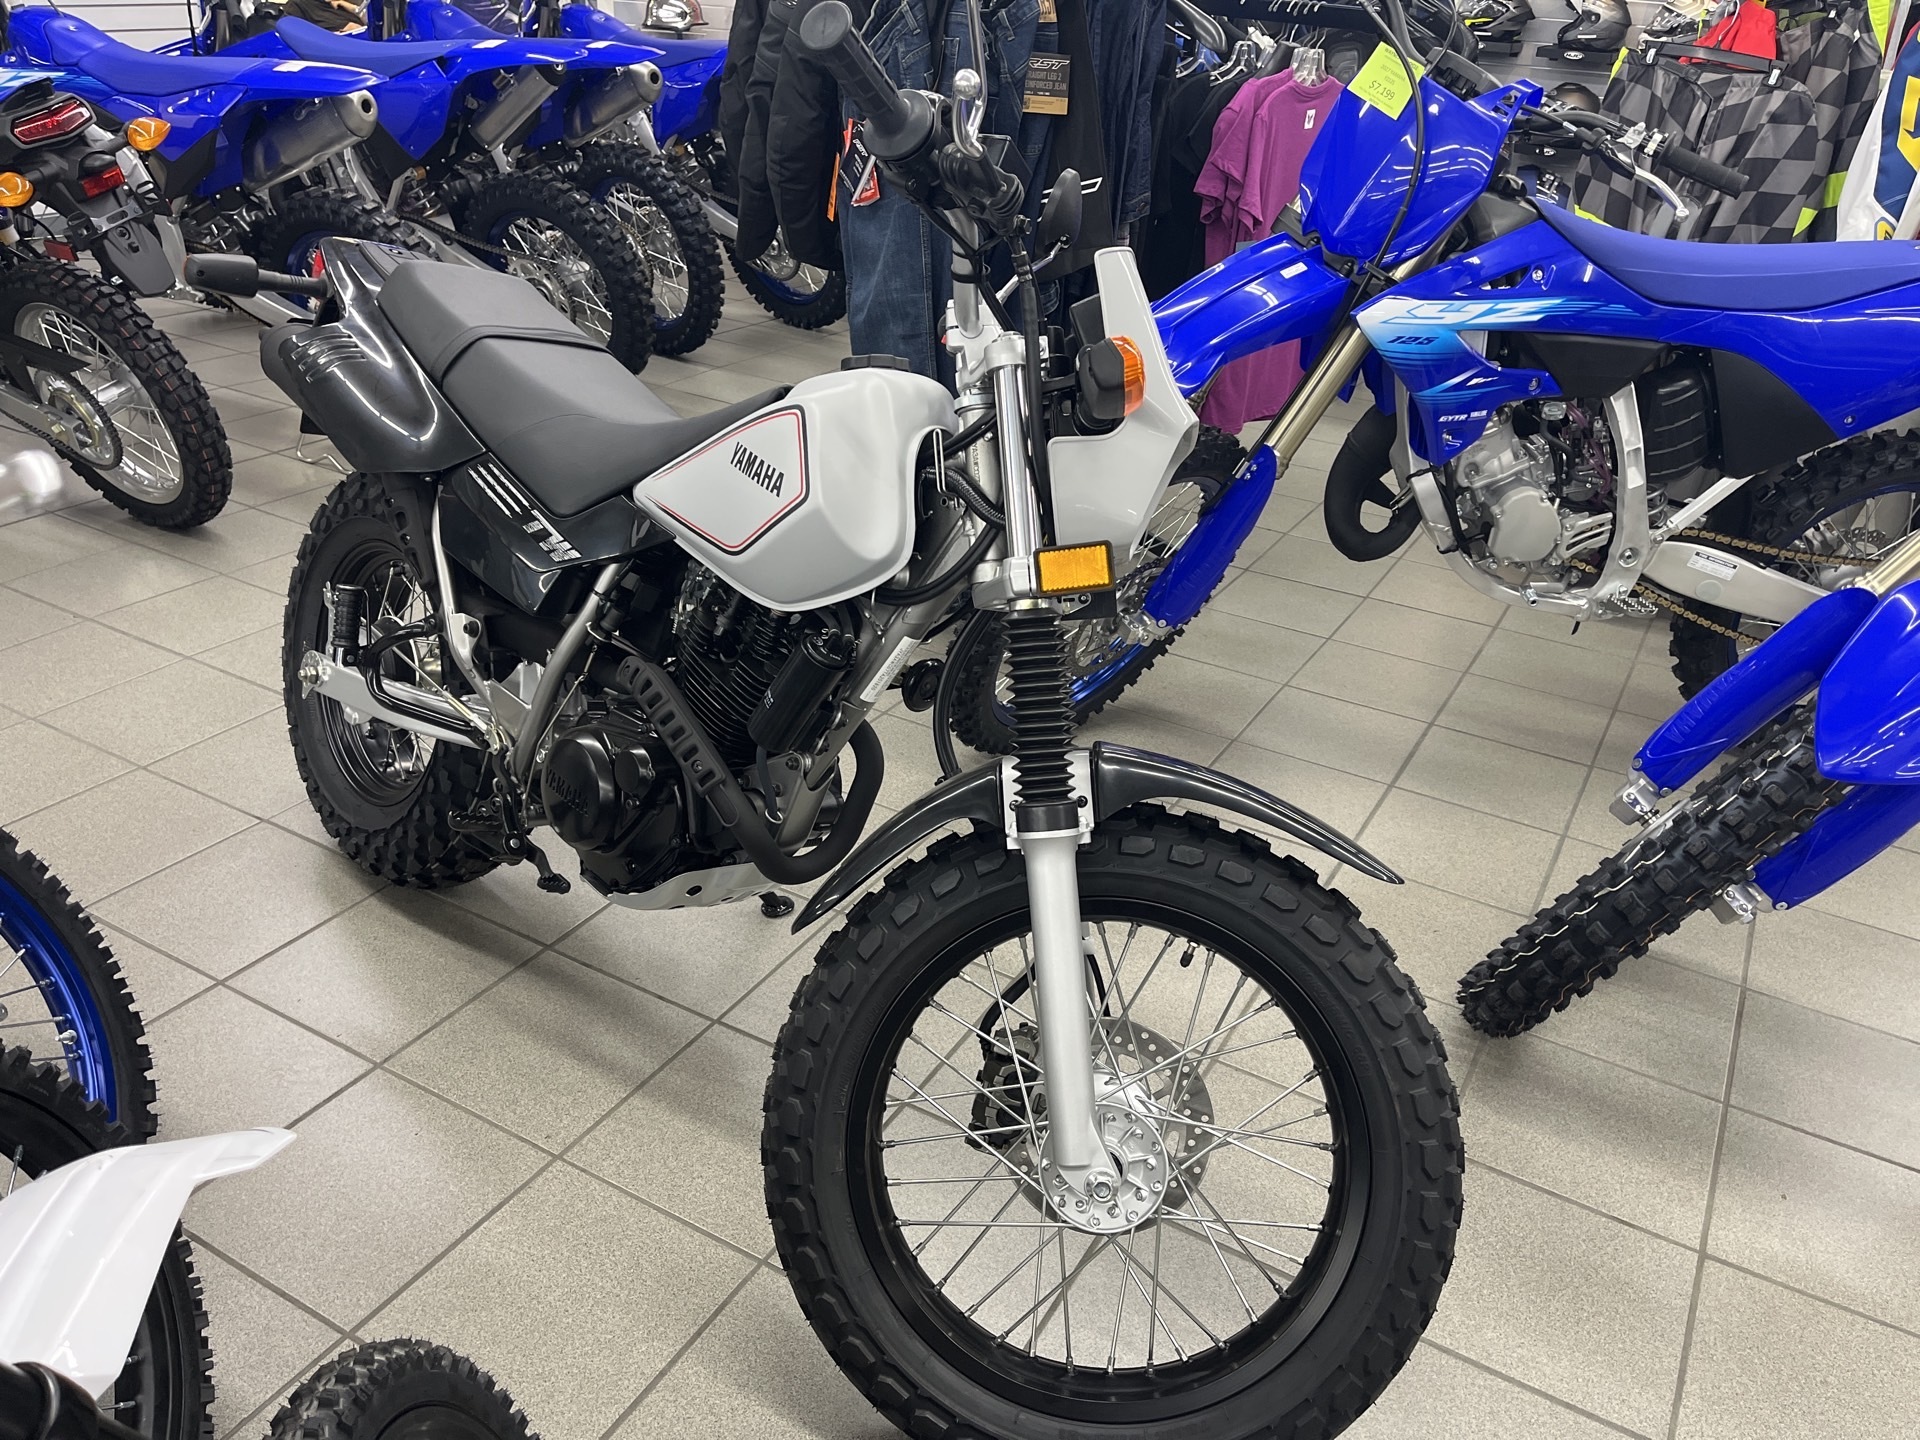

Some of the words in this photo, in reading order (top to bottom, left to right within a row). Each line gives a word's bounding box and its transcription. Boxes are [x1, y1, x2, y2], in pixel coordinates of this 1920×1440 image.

[1028, 57, 1070, 69] RST
[1368, 79, 1396, 101] $7,199
[1381, 298, 1567, 324] YZ
[1386, 335, 1439, 346] 125
[1438, 413, 1469, 422] GYTR
[730, 441, 785, 498] YAMAHA
[546, 765, 589, 817] YAMAHA
